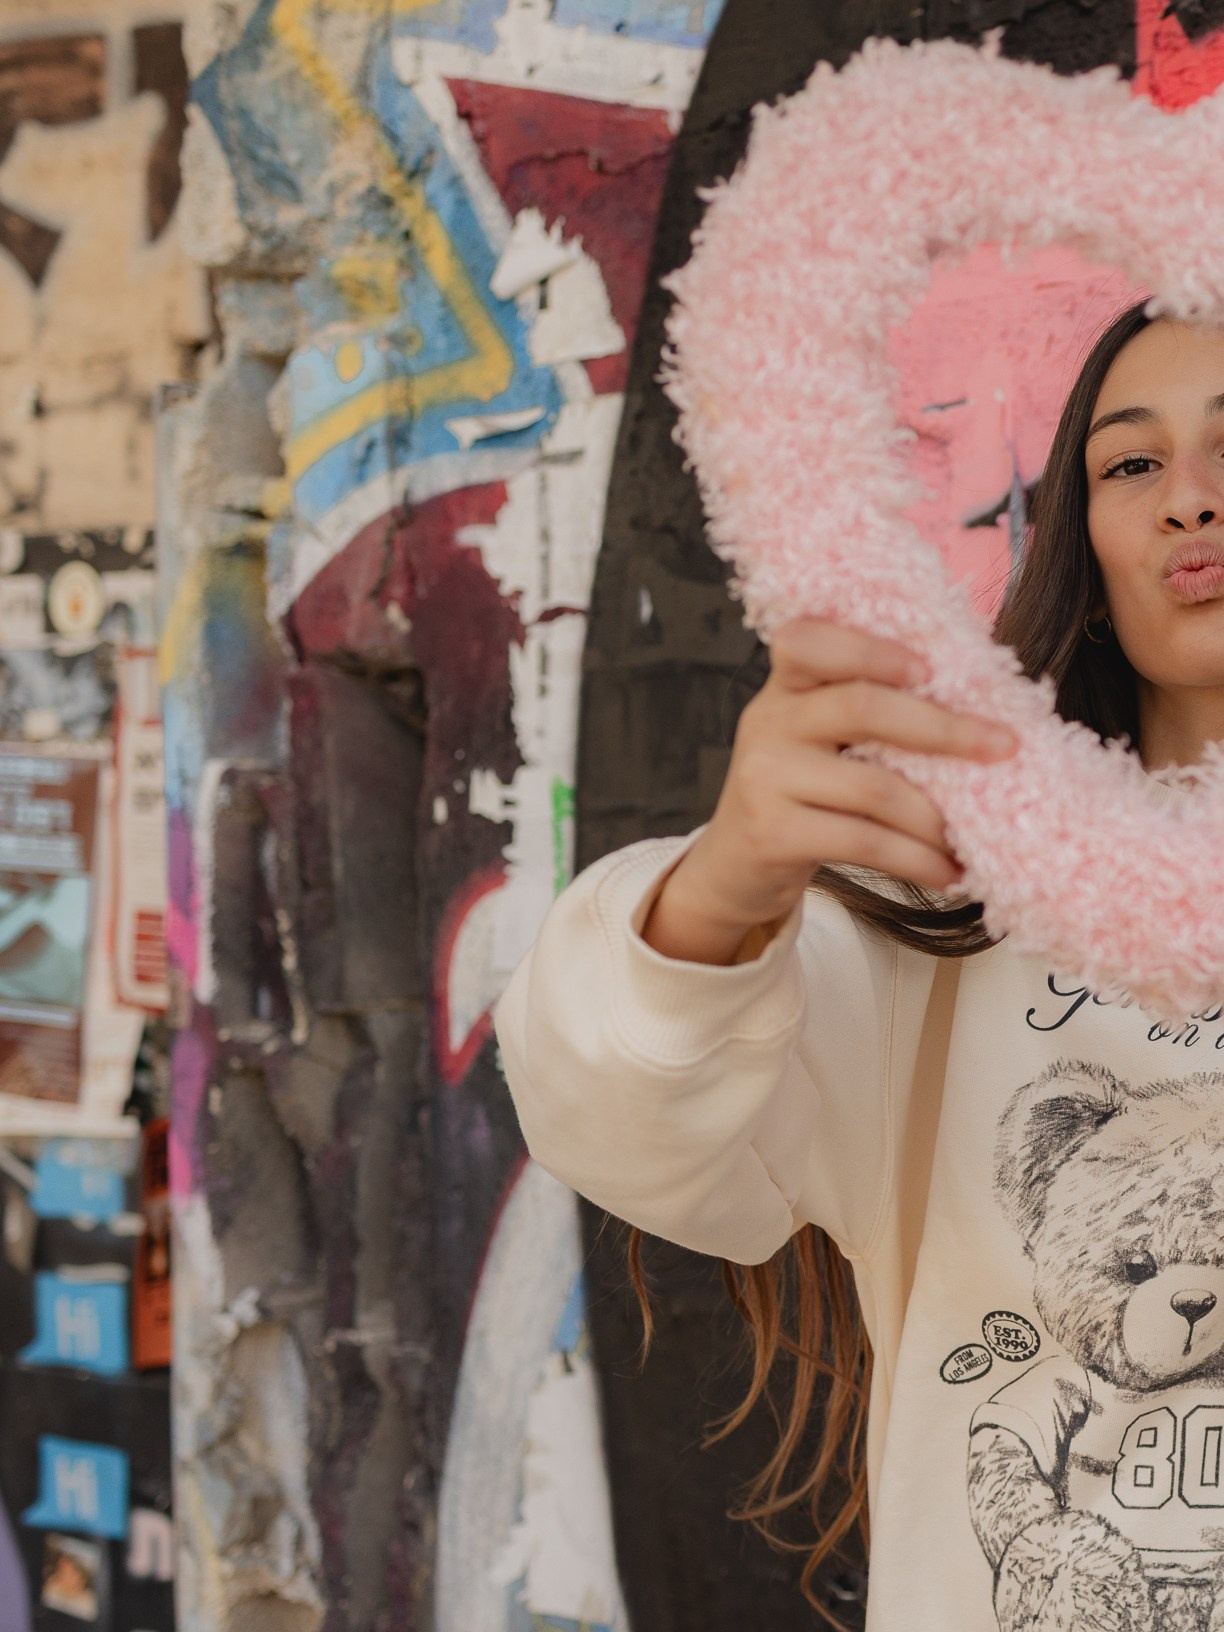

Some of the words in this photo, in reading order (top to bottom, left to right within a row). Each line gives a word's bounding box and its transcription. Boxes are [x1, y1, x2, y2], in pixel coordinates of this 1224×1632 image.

[1147, 1018, 1201, 1048] on
[993, 1325, 1026, 1340] EST.
[995, 1336, 1029, 1351] 1990
[954, 1349, 974, 1366] FROM
[948, 1366, 965, 1381] LOS
[964, 1353, 990, 1372] ANGELES
